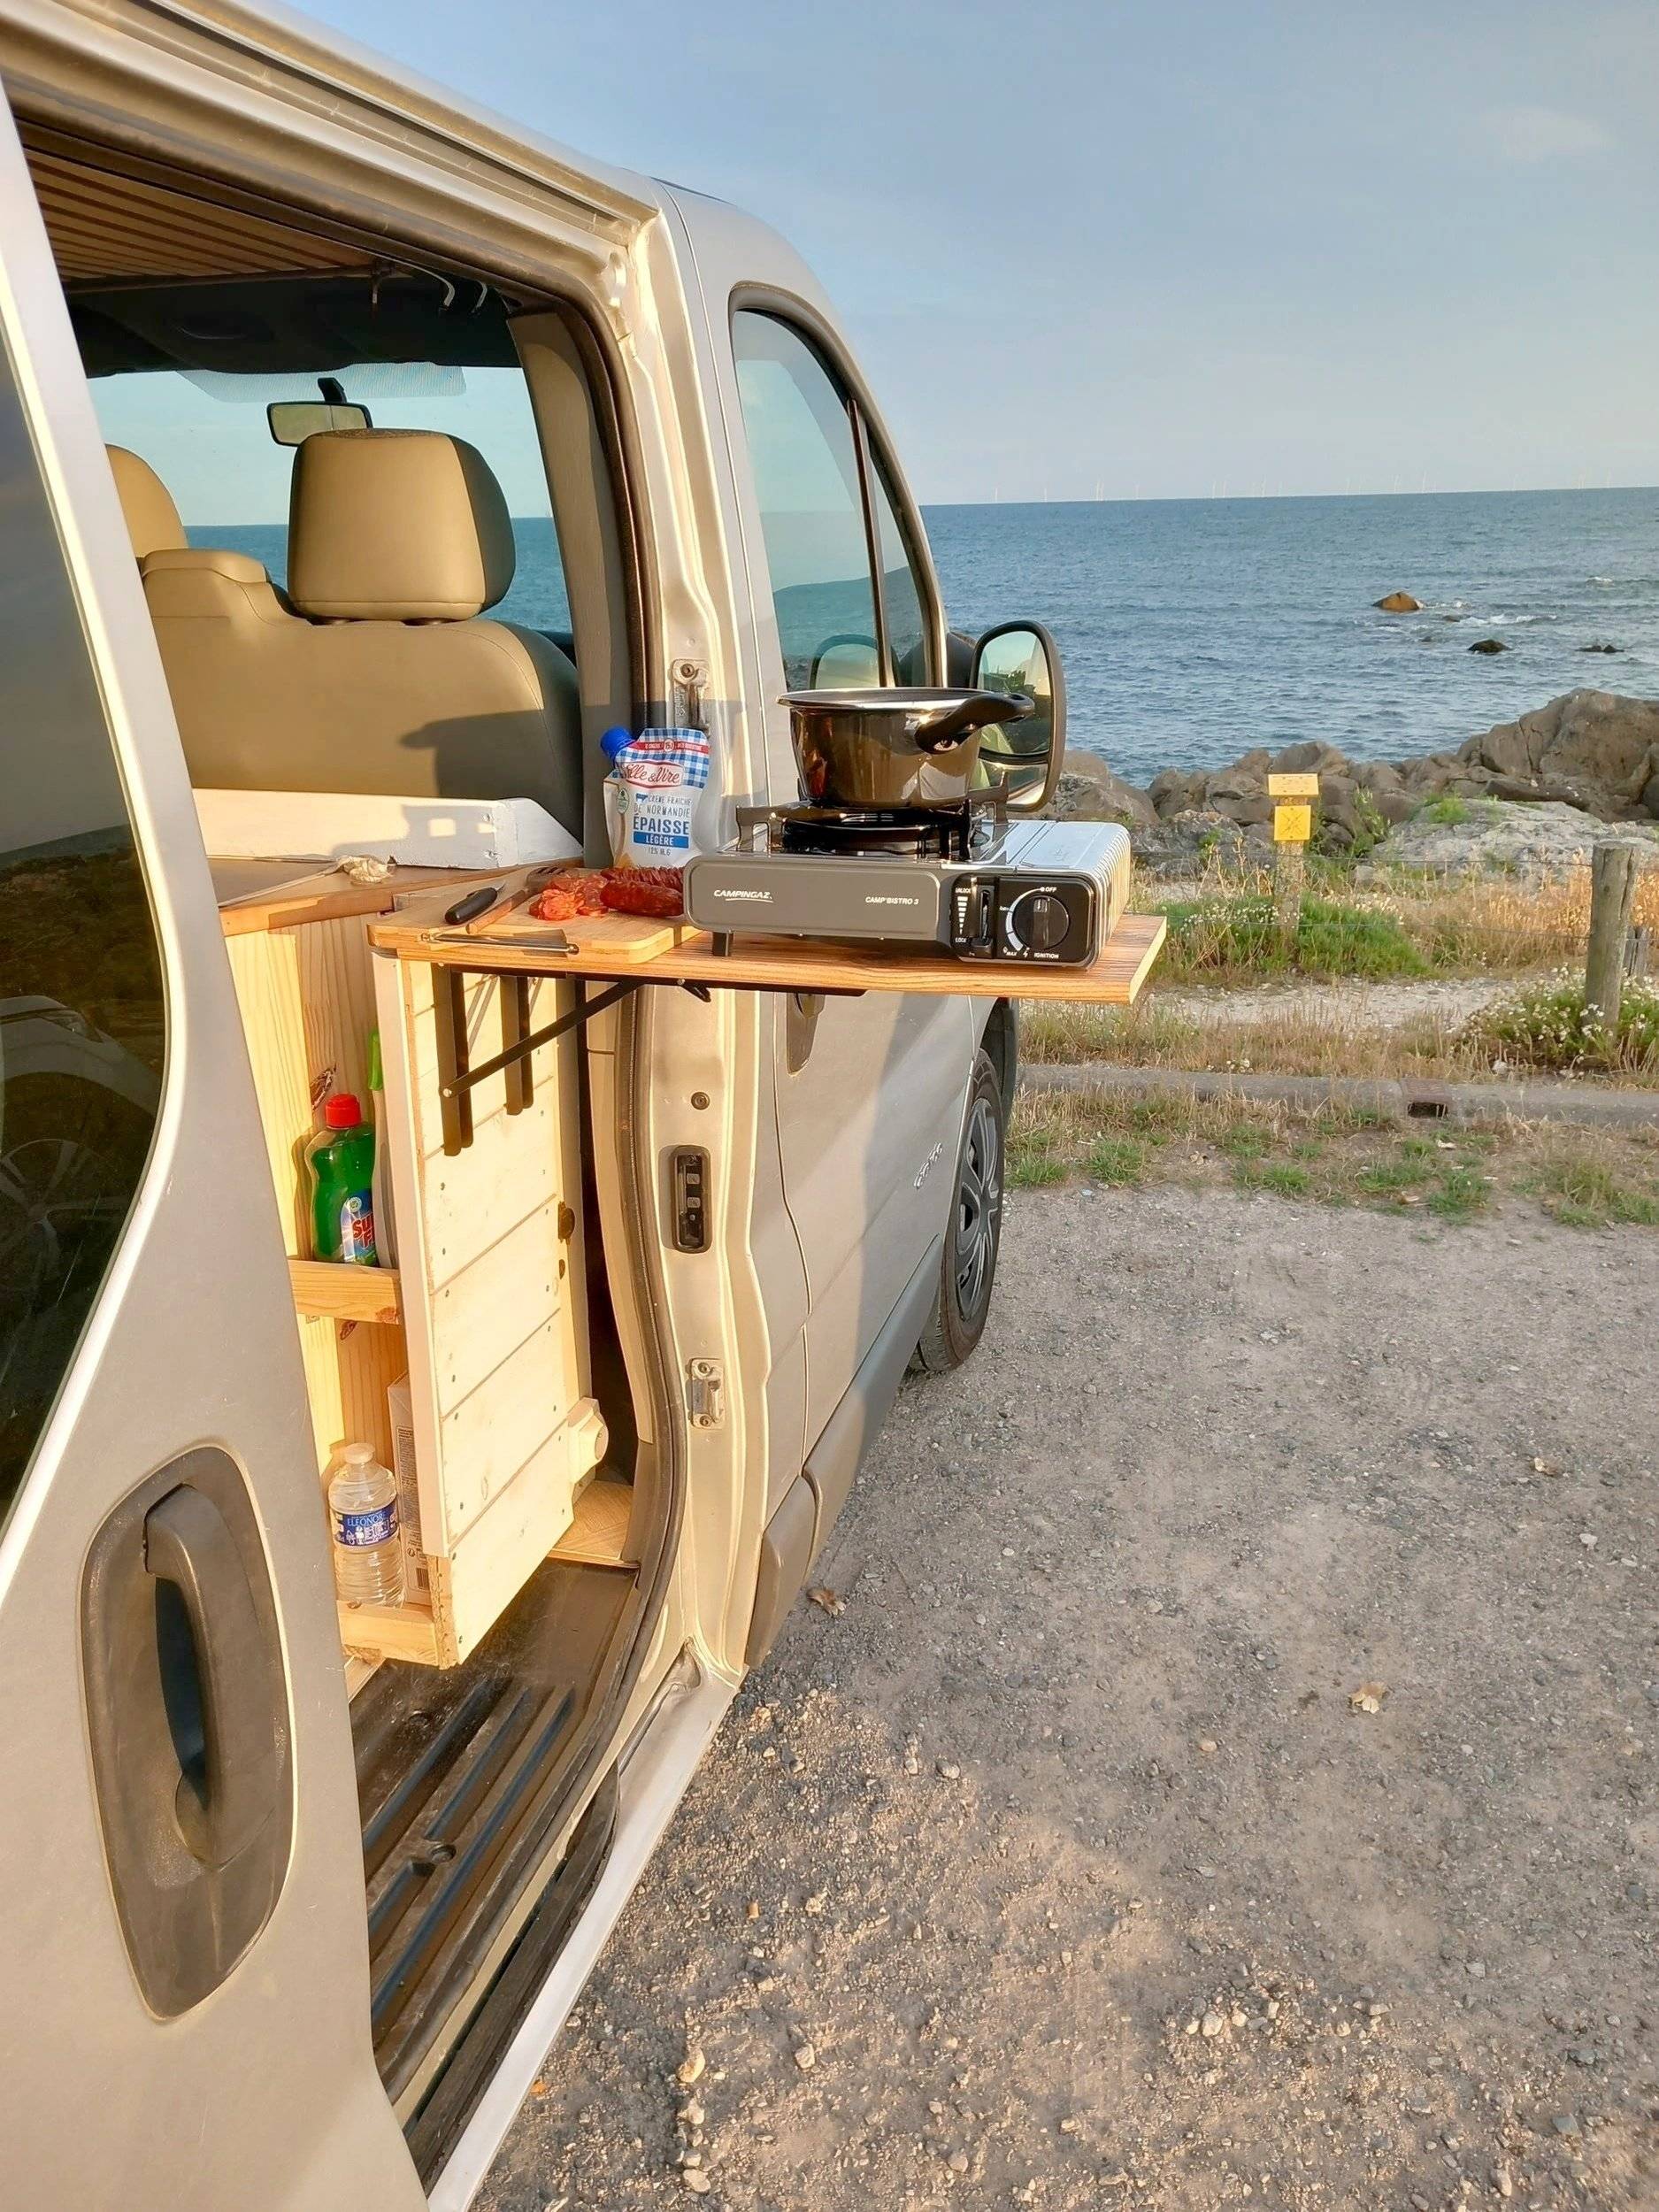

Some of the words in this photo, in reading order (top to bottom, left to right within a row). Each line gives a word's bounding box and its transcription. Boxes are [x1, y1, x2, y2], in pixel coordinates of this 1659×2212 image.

[656, 766, 680, 783] Vire
[647, 804, 691, 818] NORMANDIE
[634, 813, 690, 835] ÉPAISSE
[713, 889, 772, 900] CAMPINGAZ
[352, 1213, 374, 1240] SU
